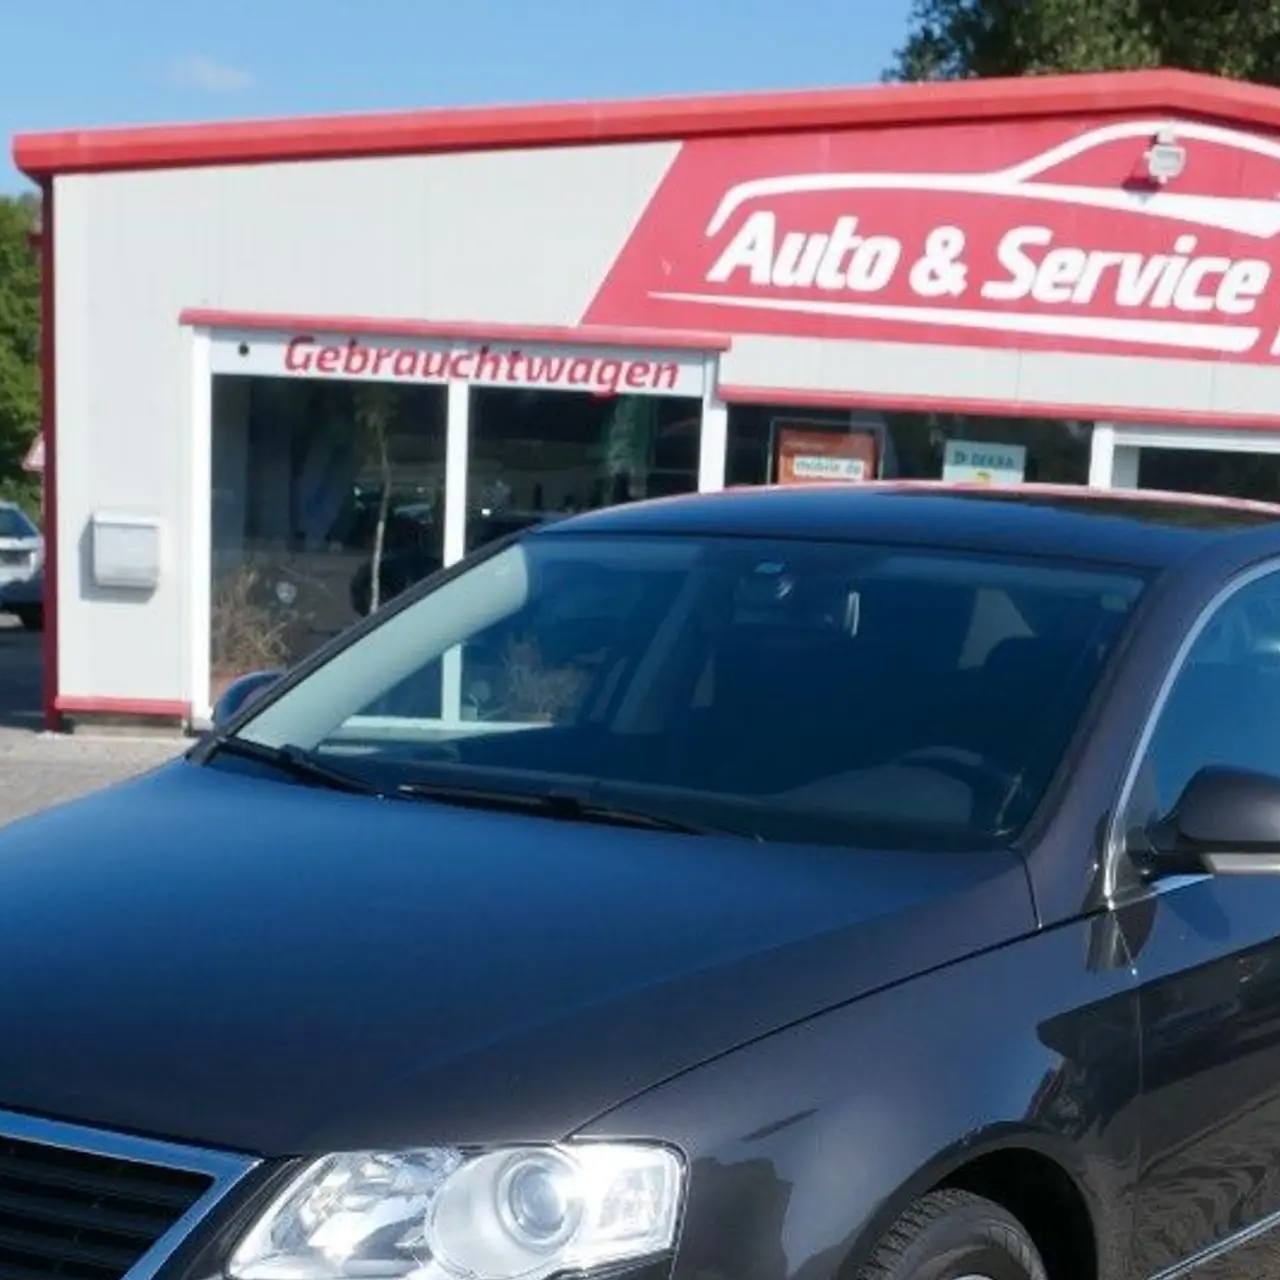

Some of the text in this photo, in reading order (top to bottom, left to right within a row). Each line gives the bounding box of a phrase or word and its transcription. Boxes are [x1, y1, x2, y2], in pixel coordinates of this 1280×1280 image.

[706, 210, 902, 291] Auto
[908, 225, 968, 297] &
[979, 225, 1271, 314] Service
[283, 336, 680, 402] Gebrauchtwagen
